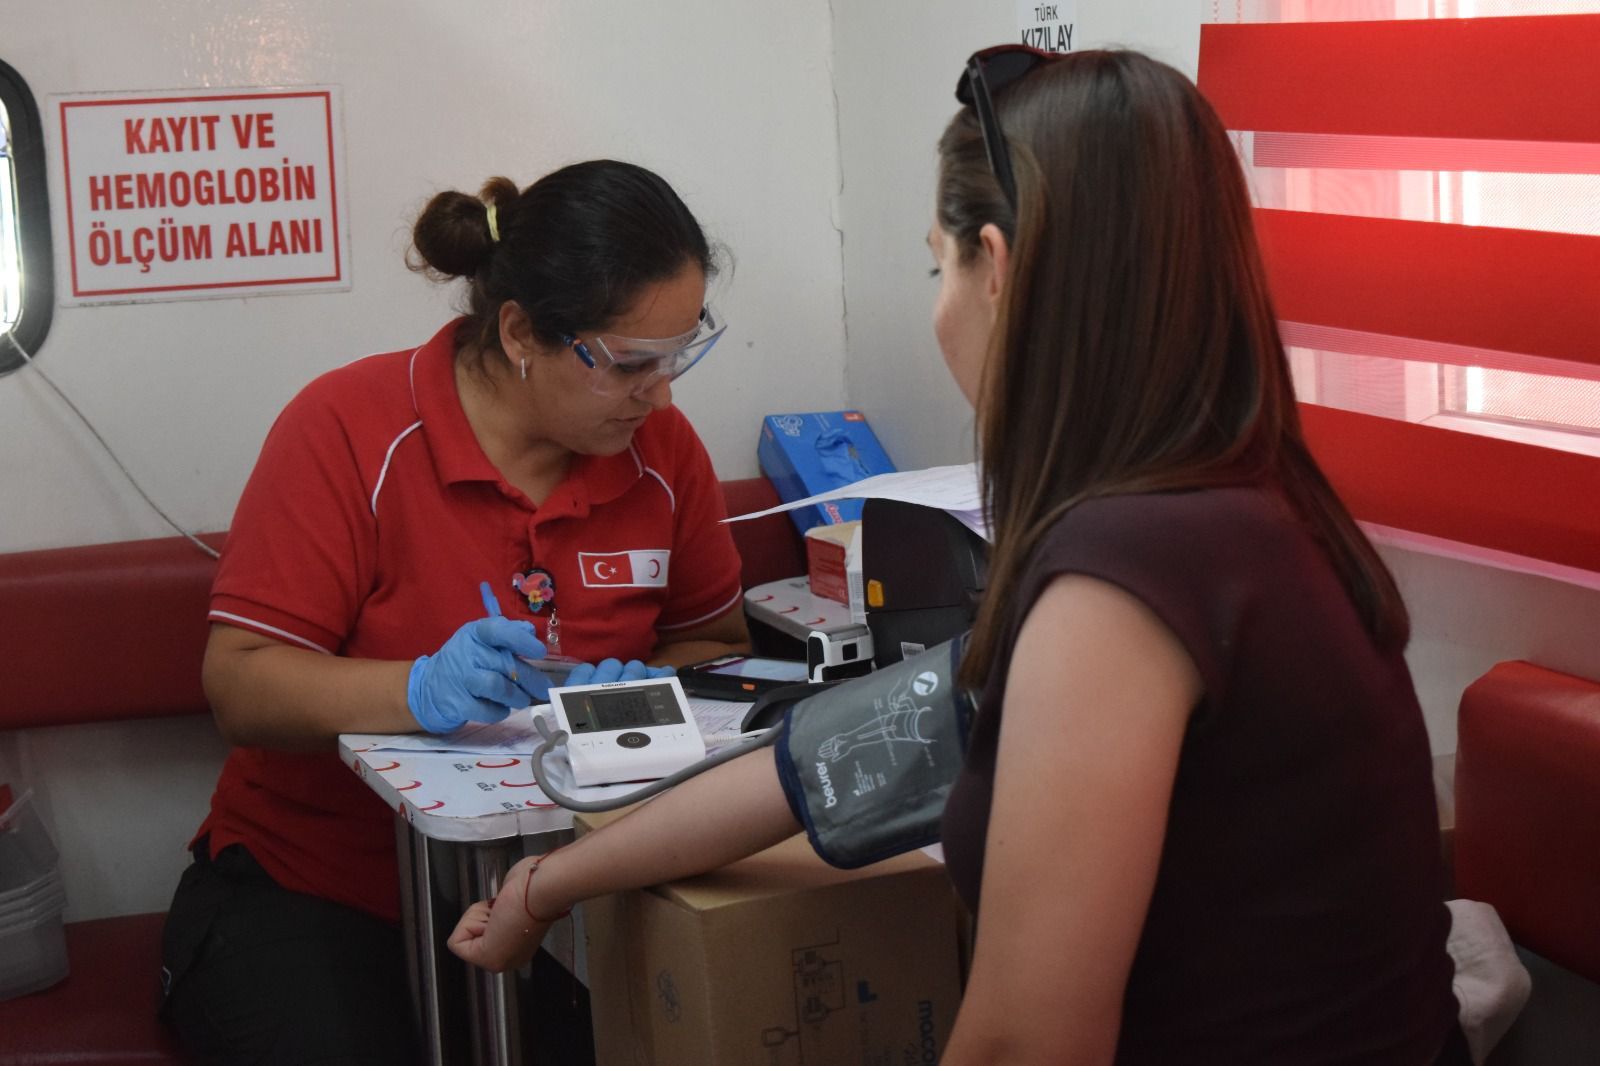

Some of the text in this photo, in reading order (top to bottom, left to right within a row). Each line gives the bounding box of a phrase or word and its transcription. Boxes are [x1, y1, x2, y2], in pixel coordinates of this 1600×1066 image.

[1034, 3, 1059, 22] TÜRK
[124, 113, 275, 155] KAYIT VE
[89, 158, 316, 211] HEMOGLOBİN
[88, 218, 323, 273] ÖLÇÜM ALANI
[816, 762, 837, 808] beurer
[918, 1001, 938, 1066] maco
